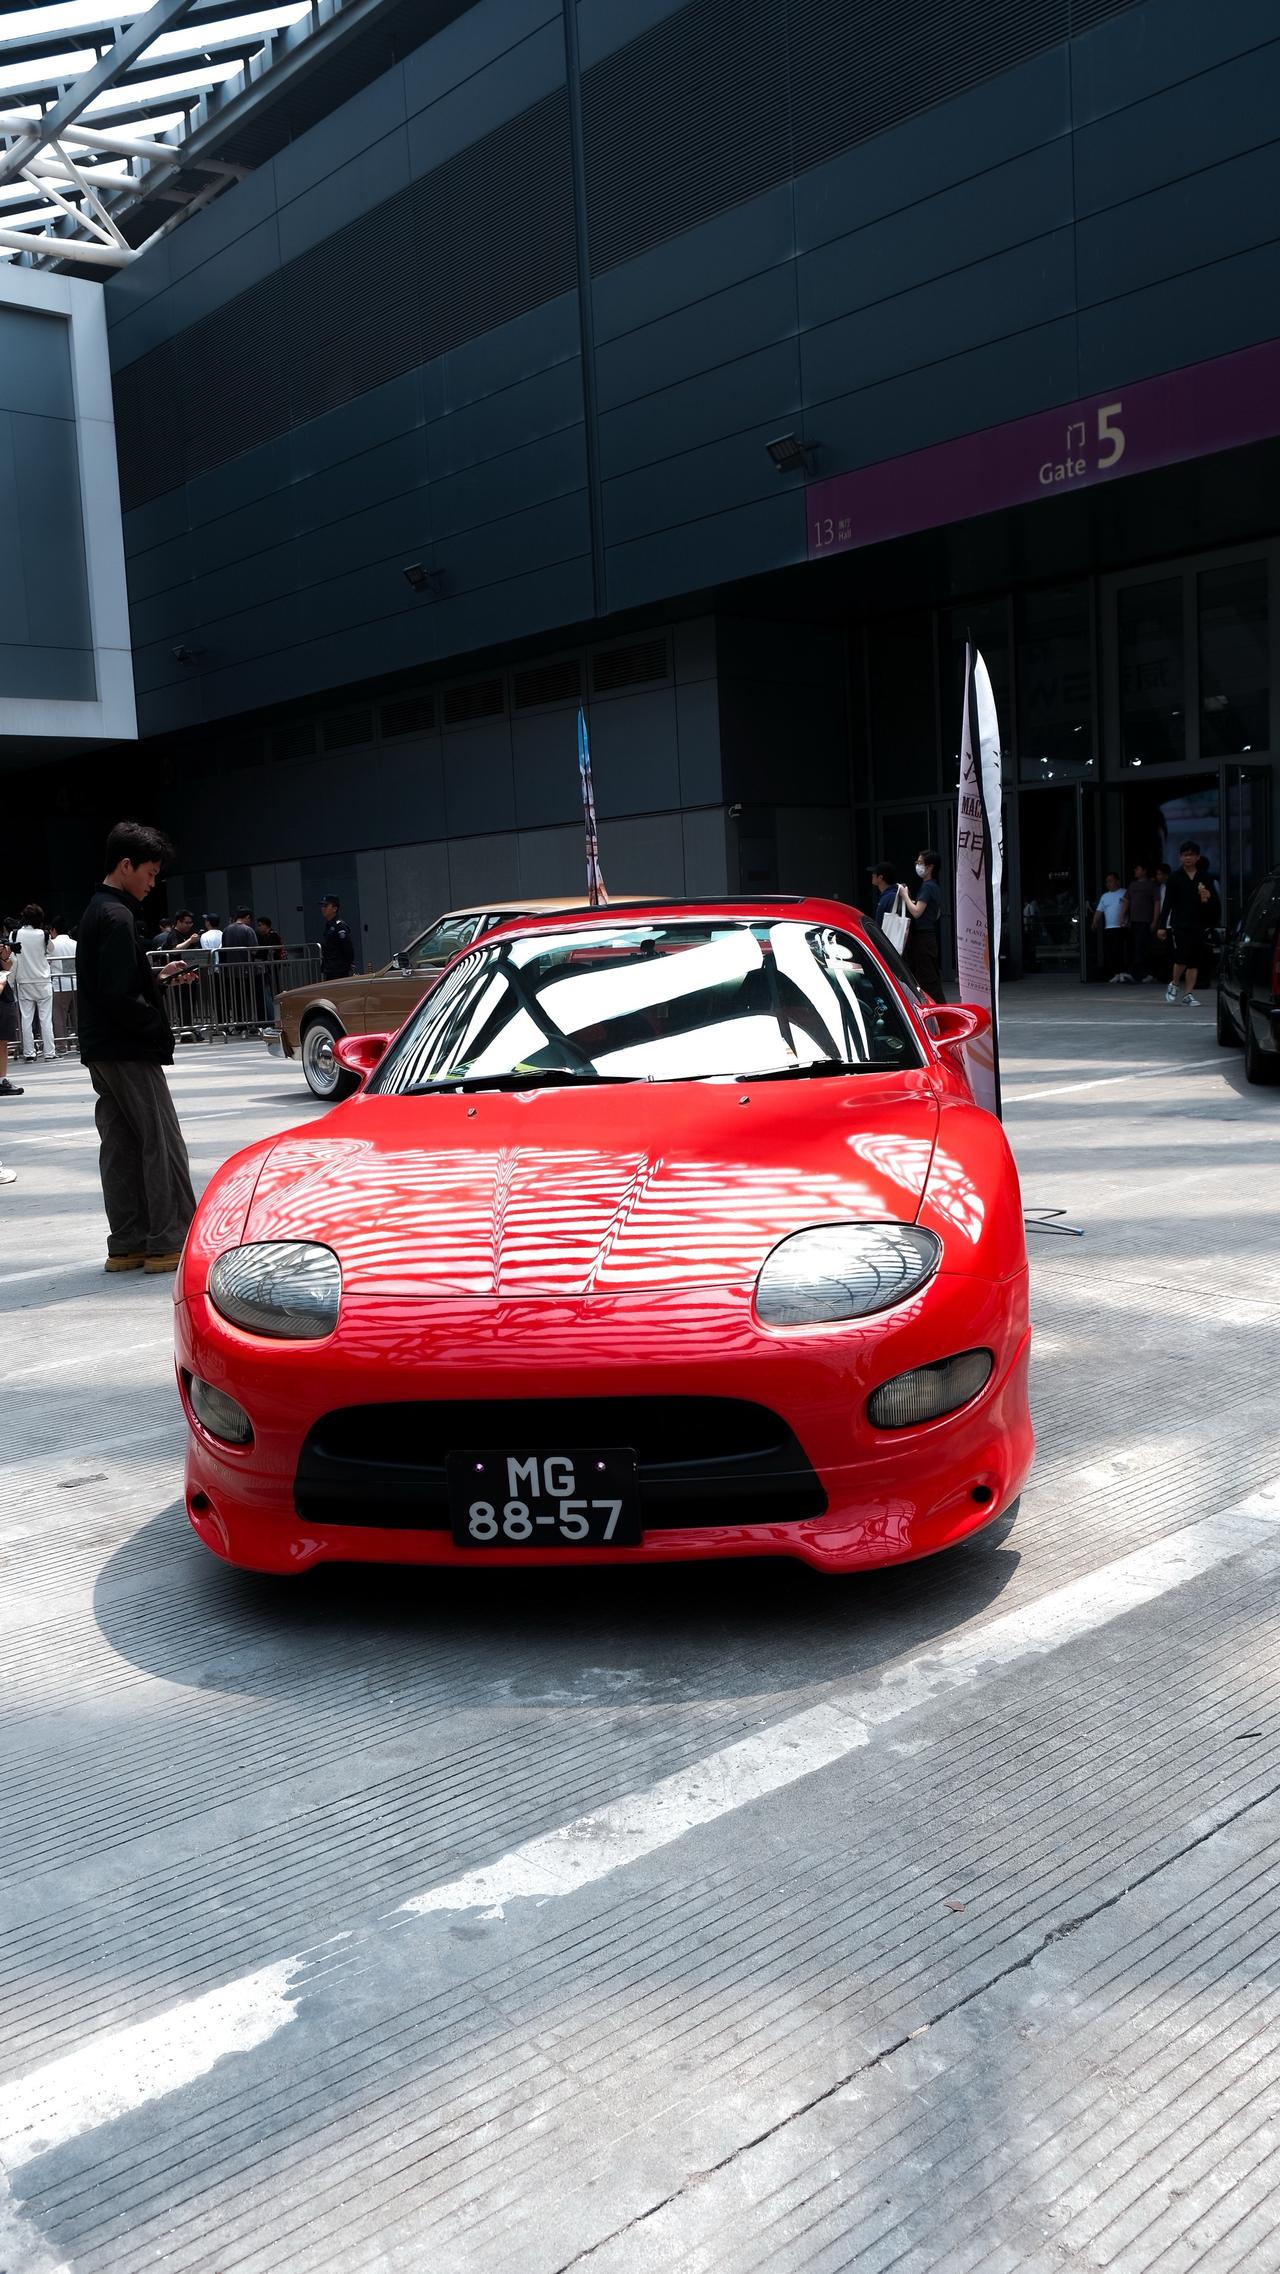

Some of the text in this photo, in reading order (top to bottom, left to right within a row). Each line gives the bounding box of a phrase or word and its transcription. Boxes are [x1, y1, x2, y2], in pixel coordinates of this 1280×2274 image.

[1039, 401, 1126, 485] Gate 5
[1066, 421, 1086, 450] 门
[814, 518, 834, 548] 13
[506, 1456, 576, 1498] MG
[468, 1499, 623, 1541] 88-57
